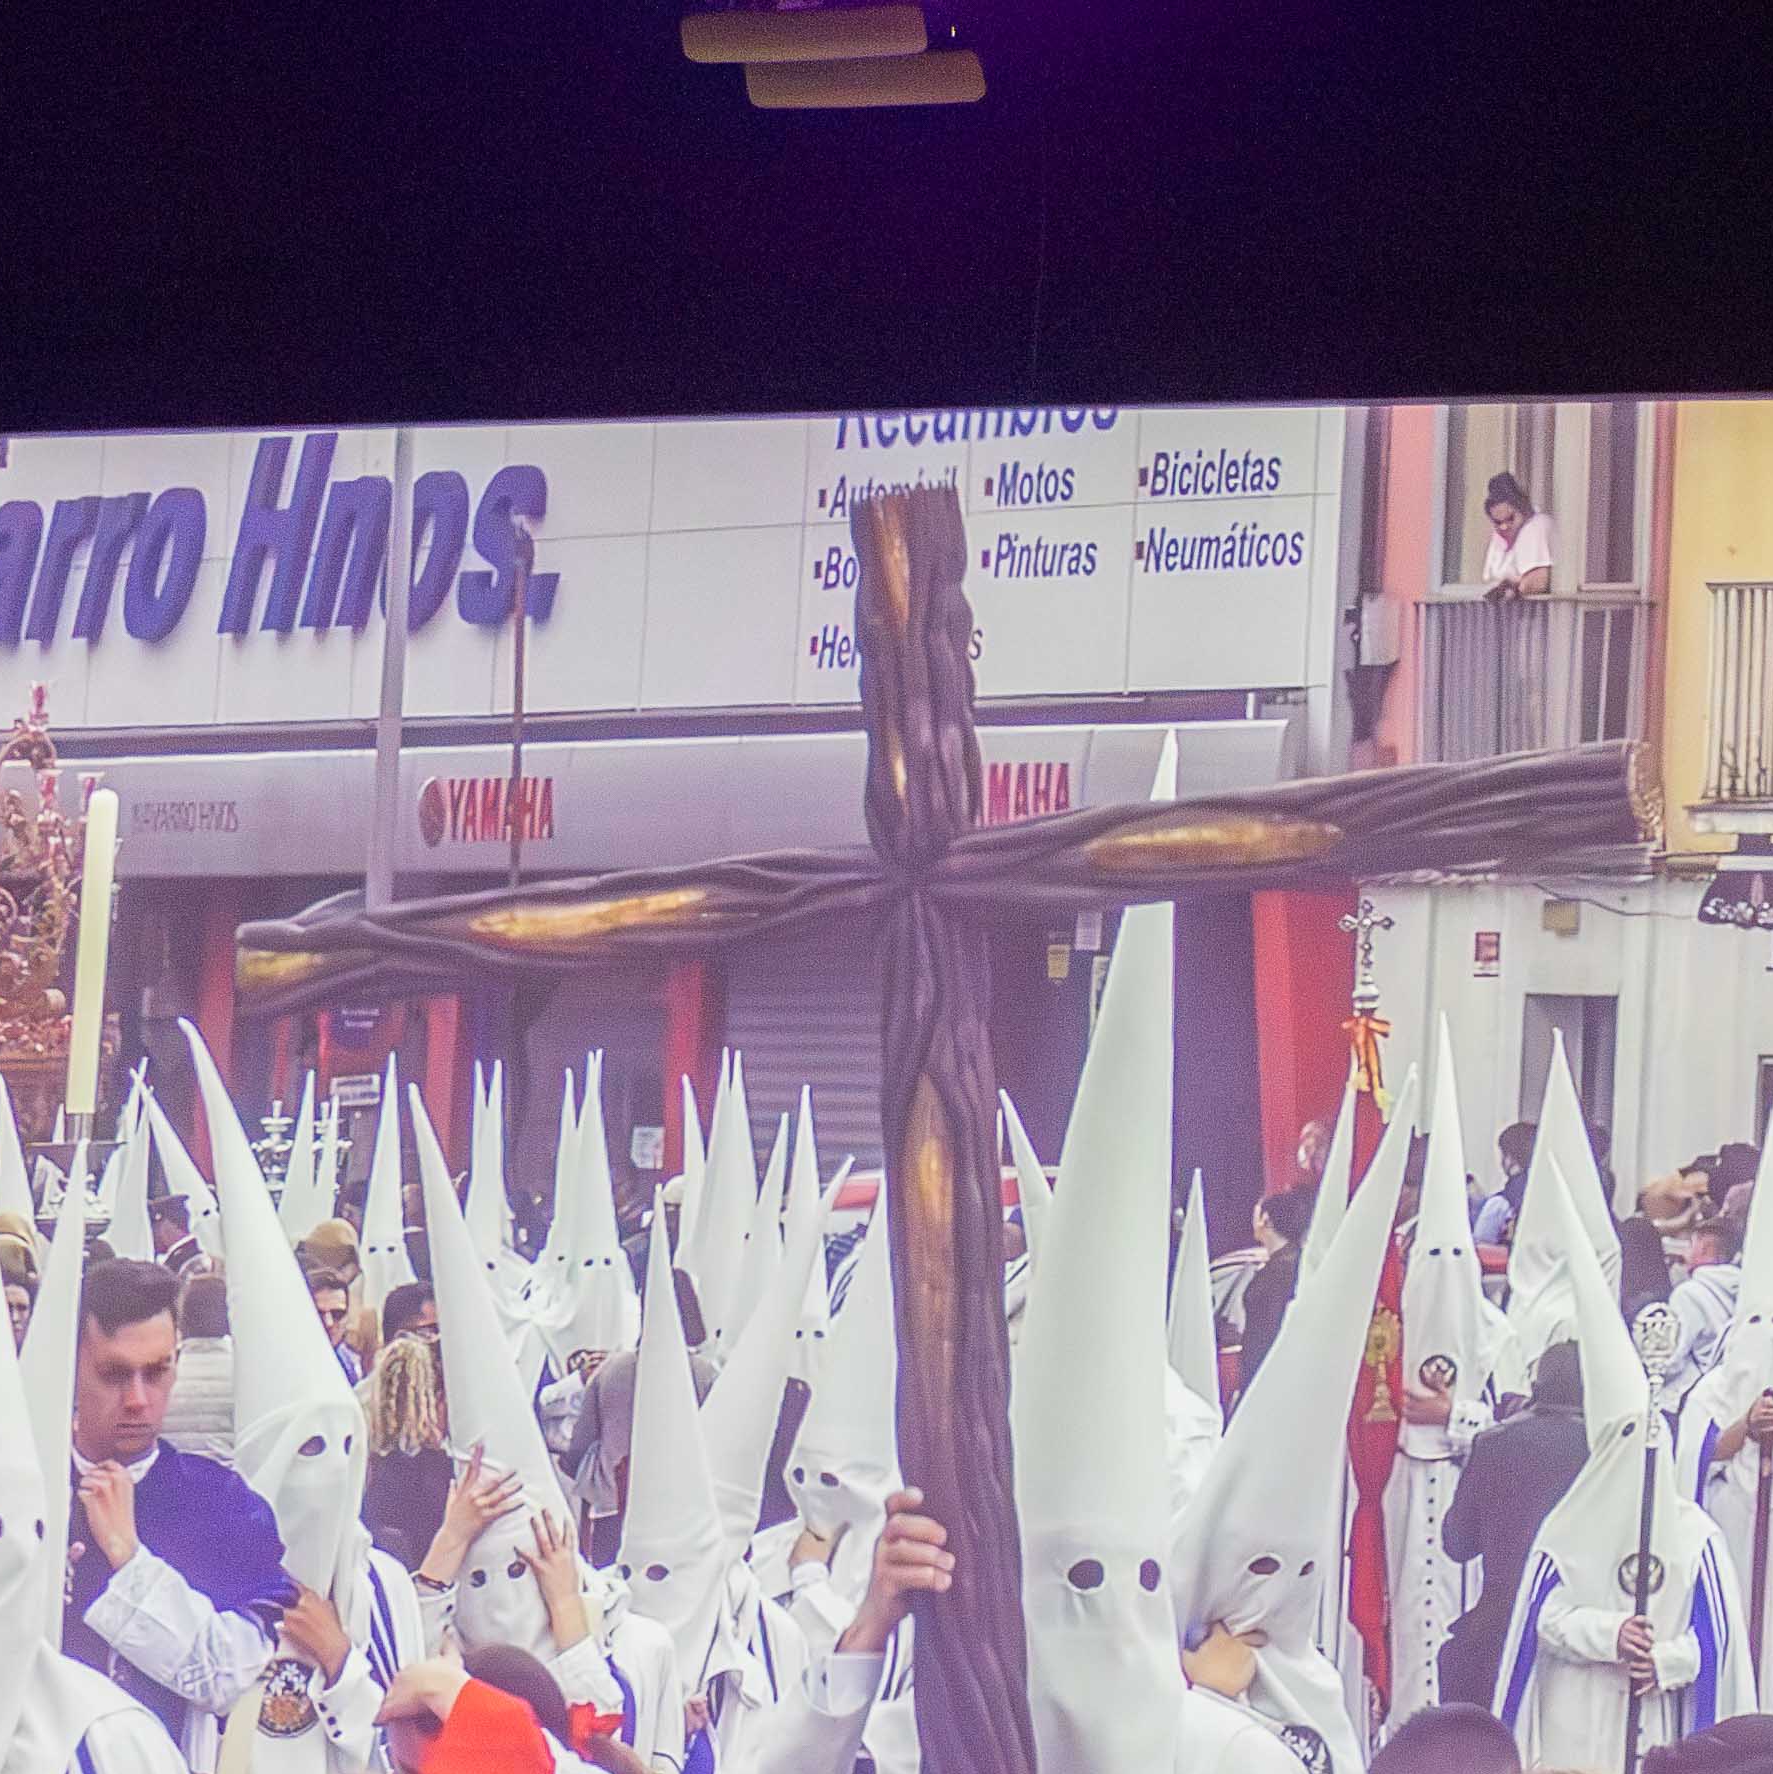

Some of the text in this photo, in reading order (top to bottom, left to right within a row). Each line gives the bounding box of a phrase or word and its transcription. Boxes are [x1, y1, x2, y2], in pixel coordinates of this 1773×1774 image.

[996, 461, 1075, 507] Motos
[1150, 448, 1282, 497] Bicicletas
[217, 432, 561, 636] Hnos.
[993, 532, 1098, 578] Pinturas
[1143, 521, 1305, 574] Neumáticos
[448, 777, 554, 841] YAMAHA
[977, 762, 1070, 826] MAHA
